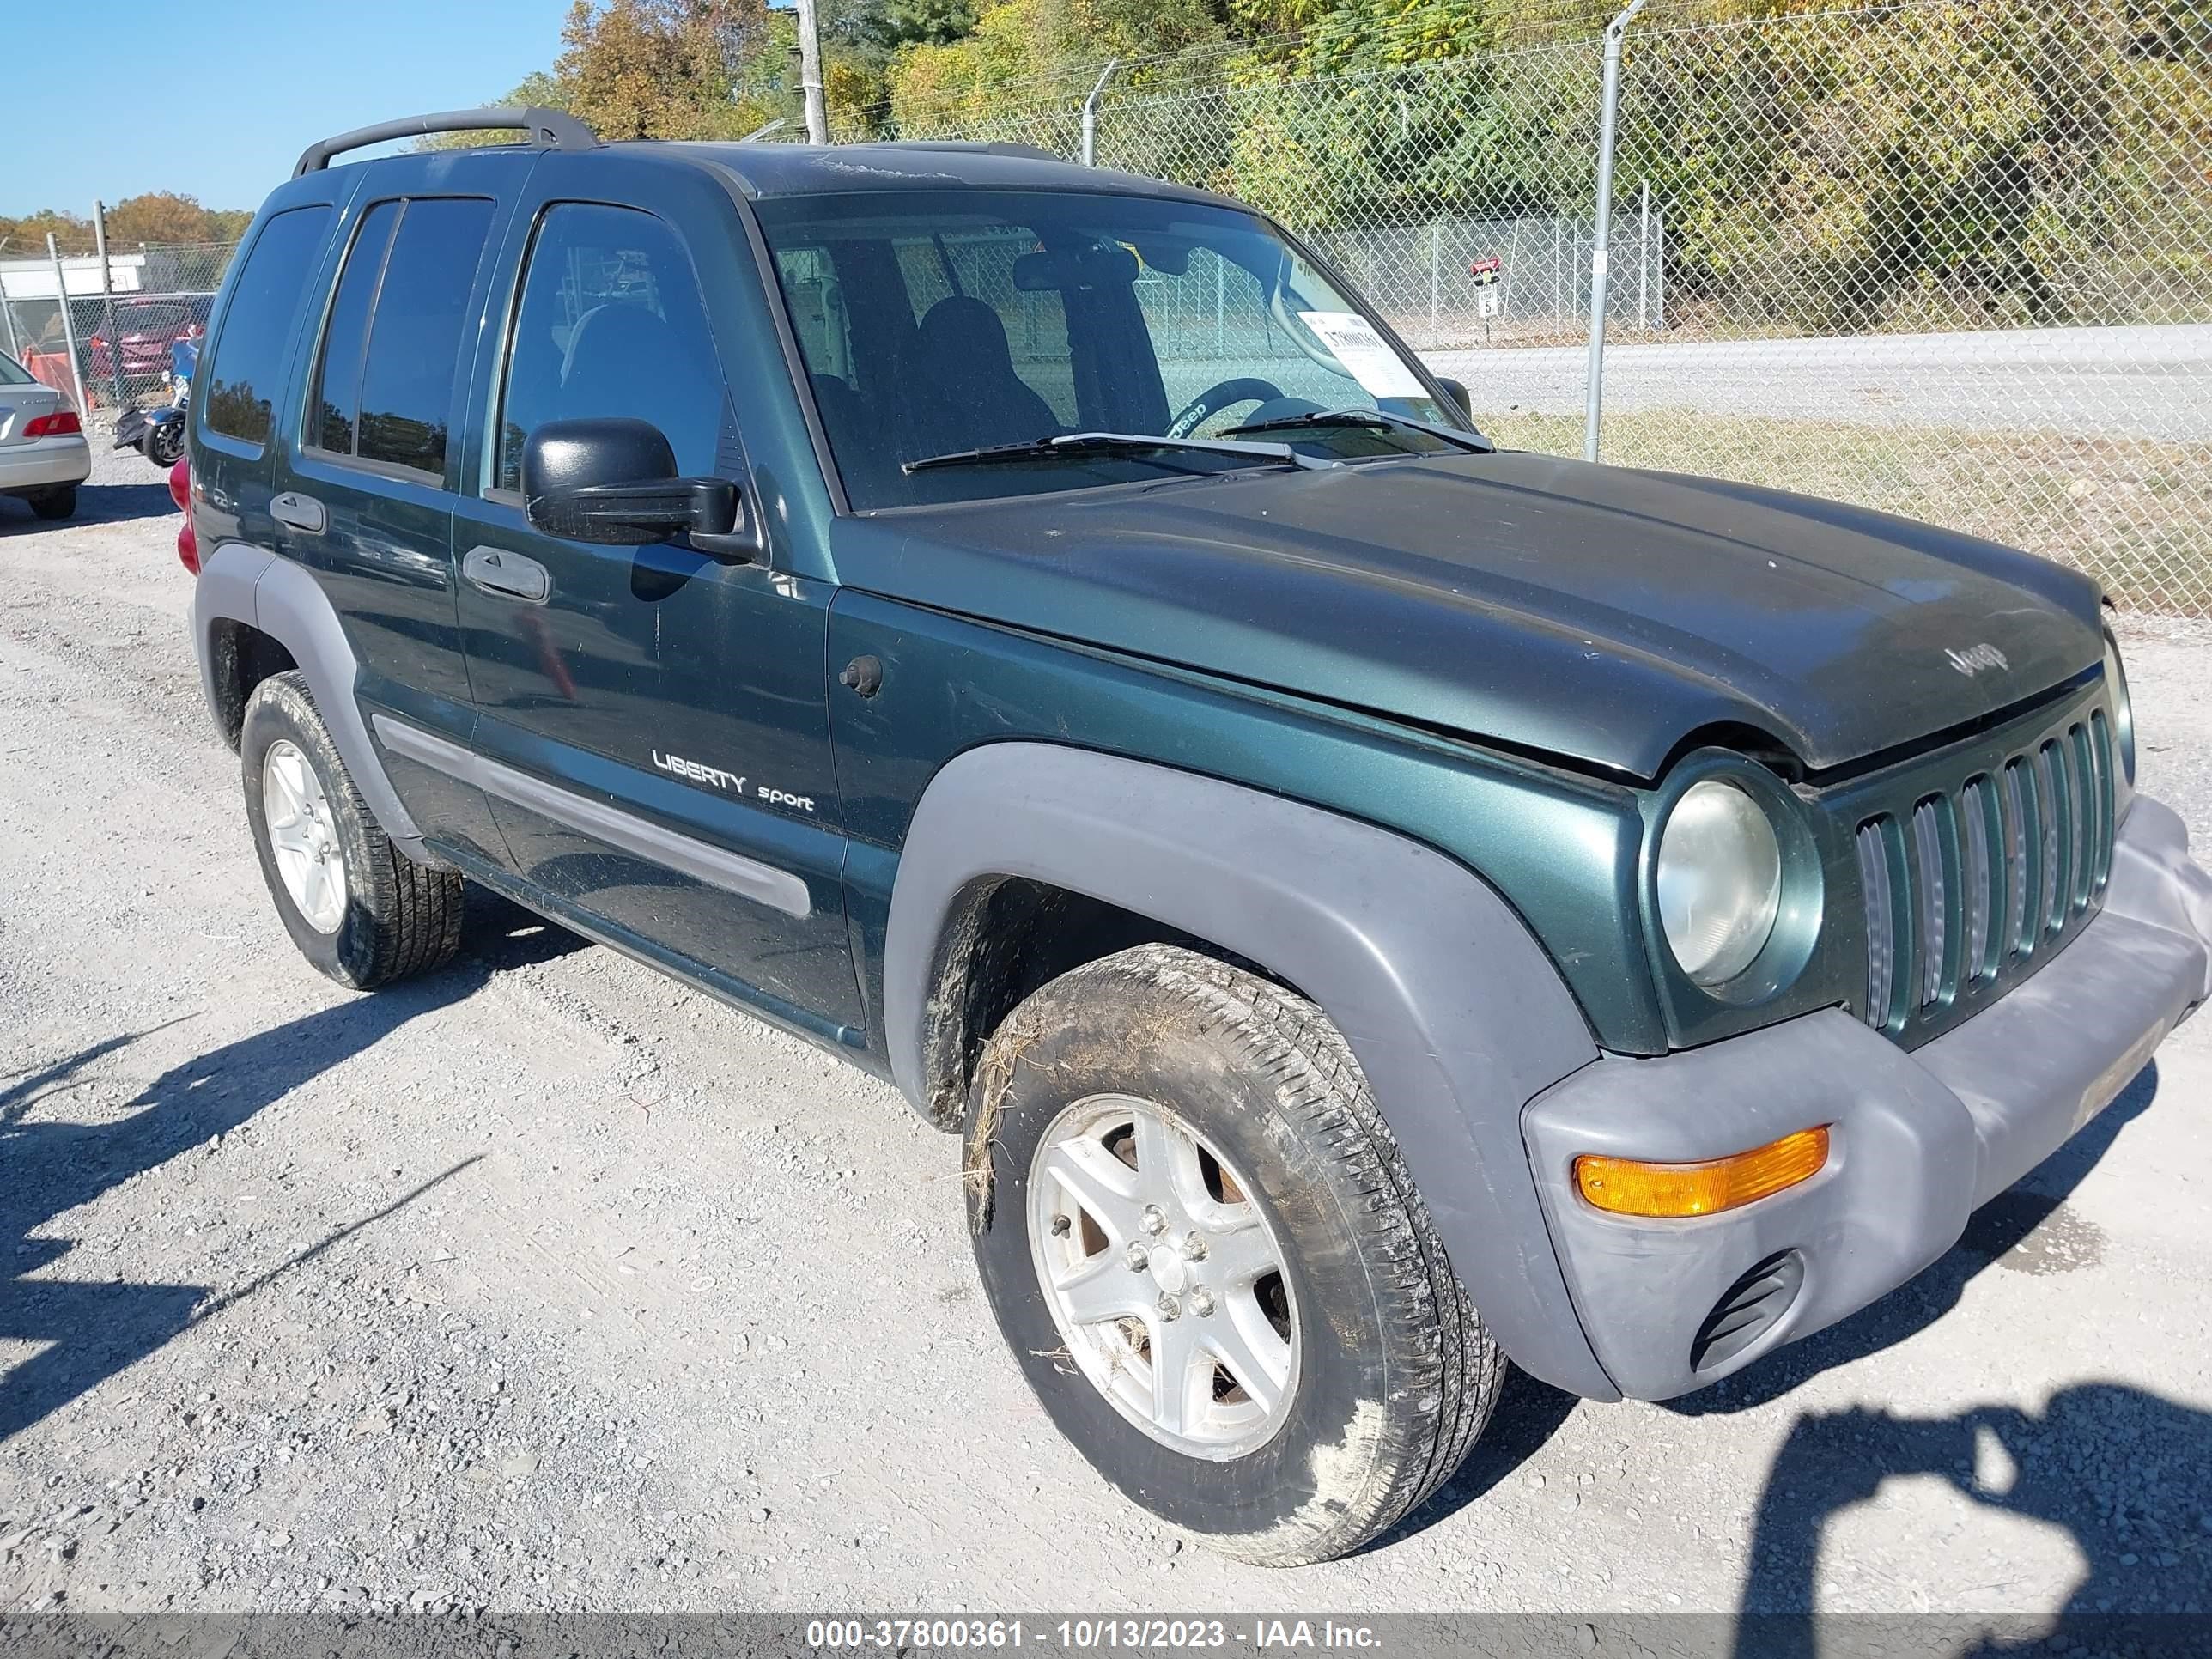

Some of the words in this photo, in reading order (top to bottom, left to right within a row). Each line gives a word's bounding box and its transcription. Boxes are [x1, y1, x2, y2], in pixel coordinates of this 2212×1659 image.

[1172, 404, 1207, 439] Jeep
[1944, 642, 2008, 677] Jeep
[652, 749, 748, 793] LIBERTY
[757, 786, 815, 811] sport
